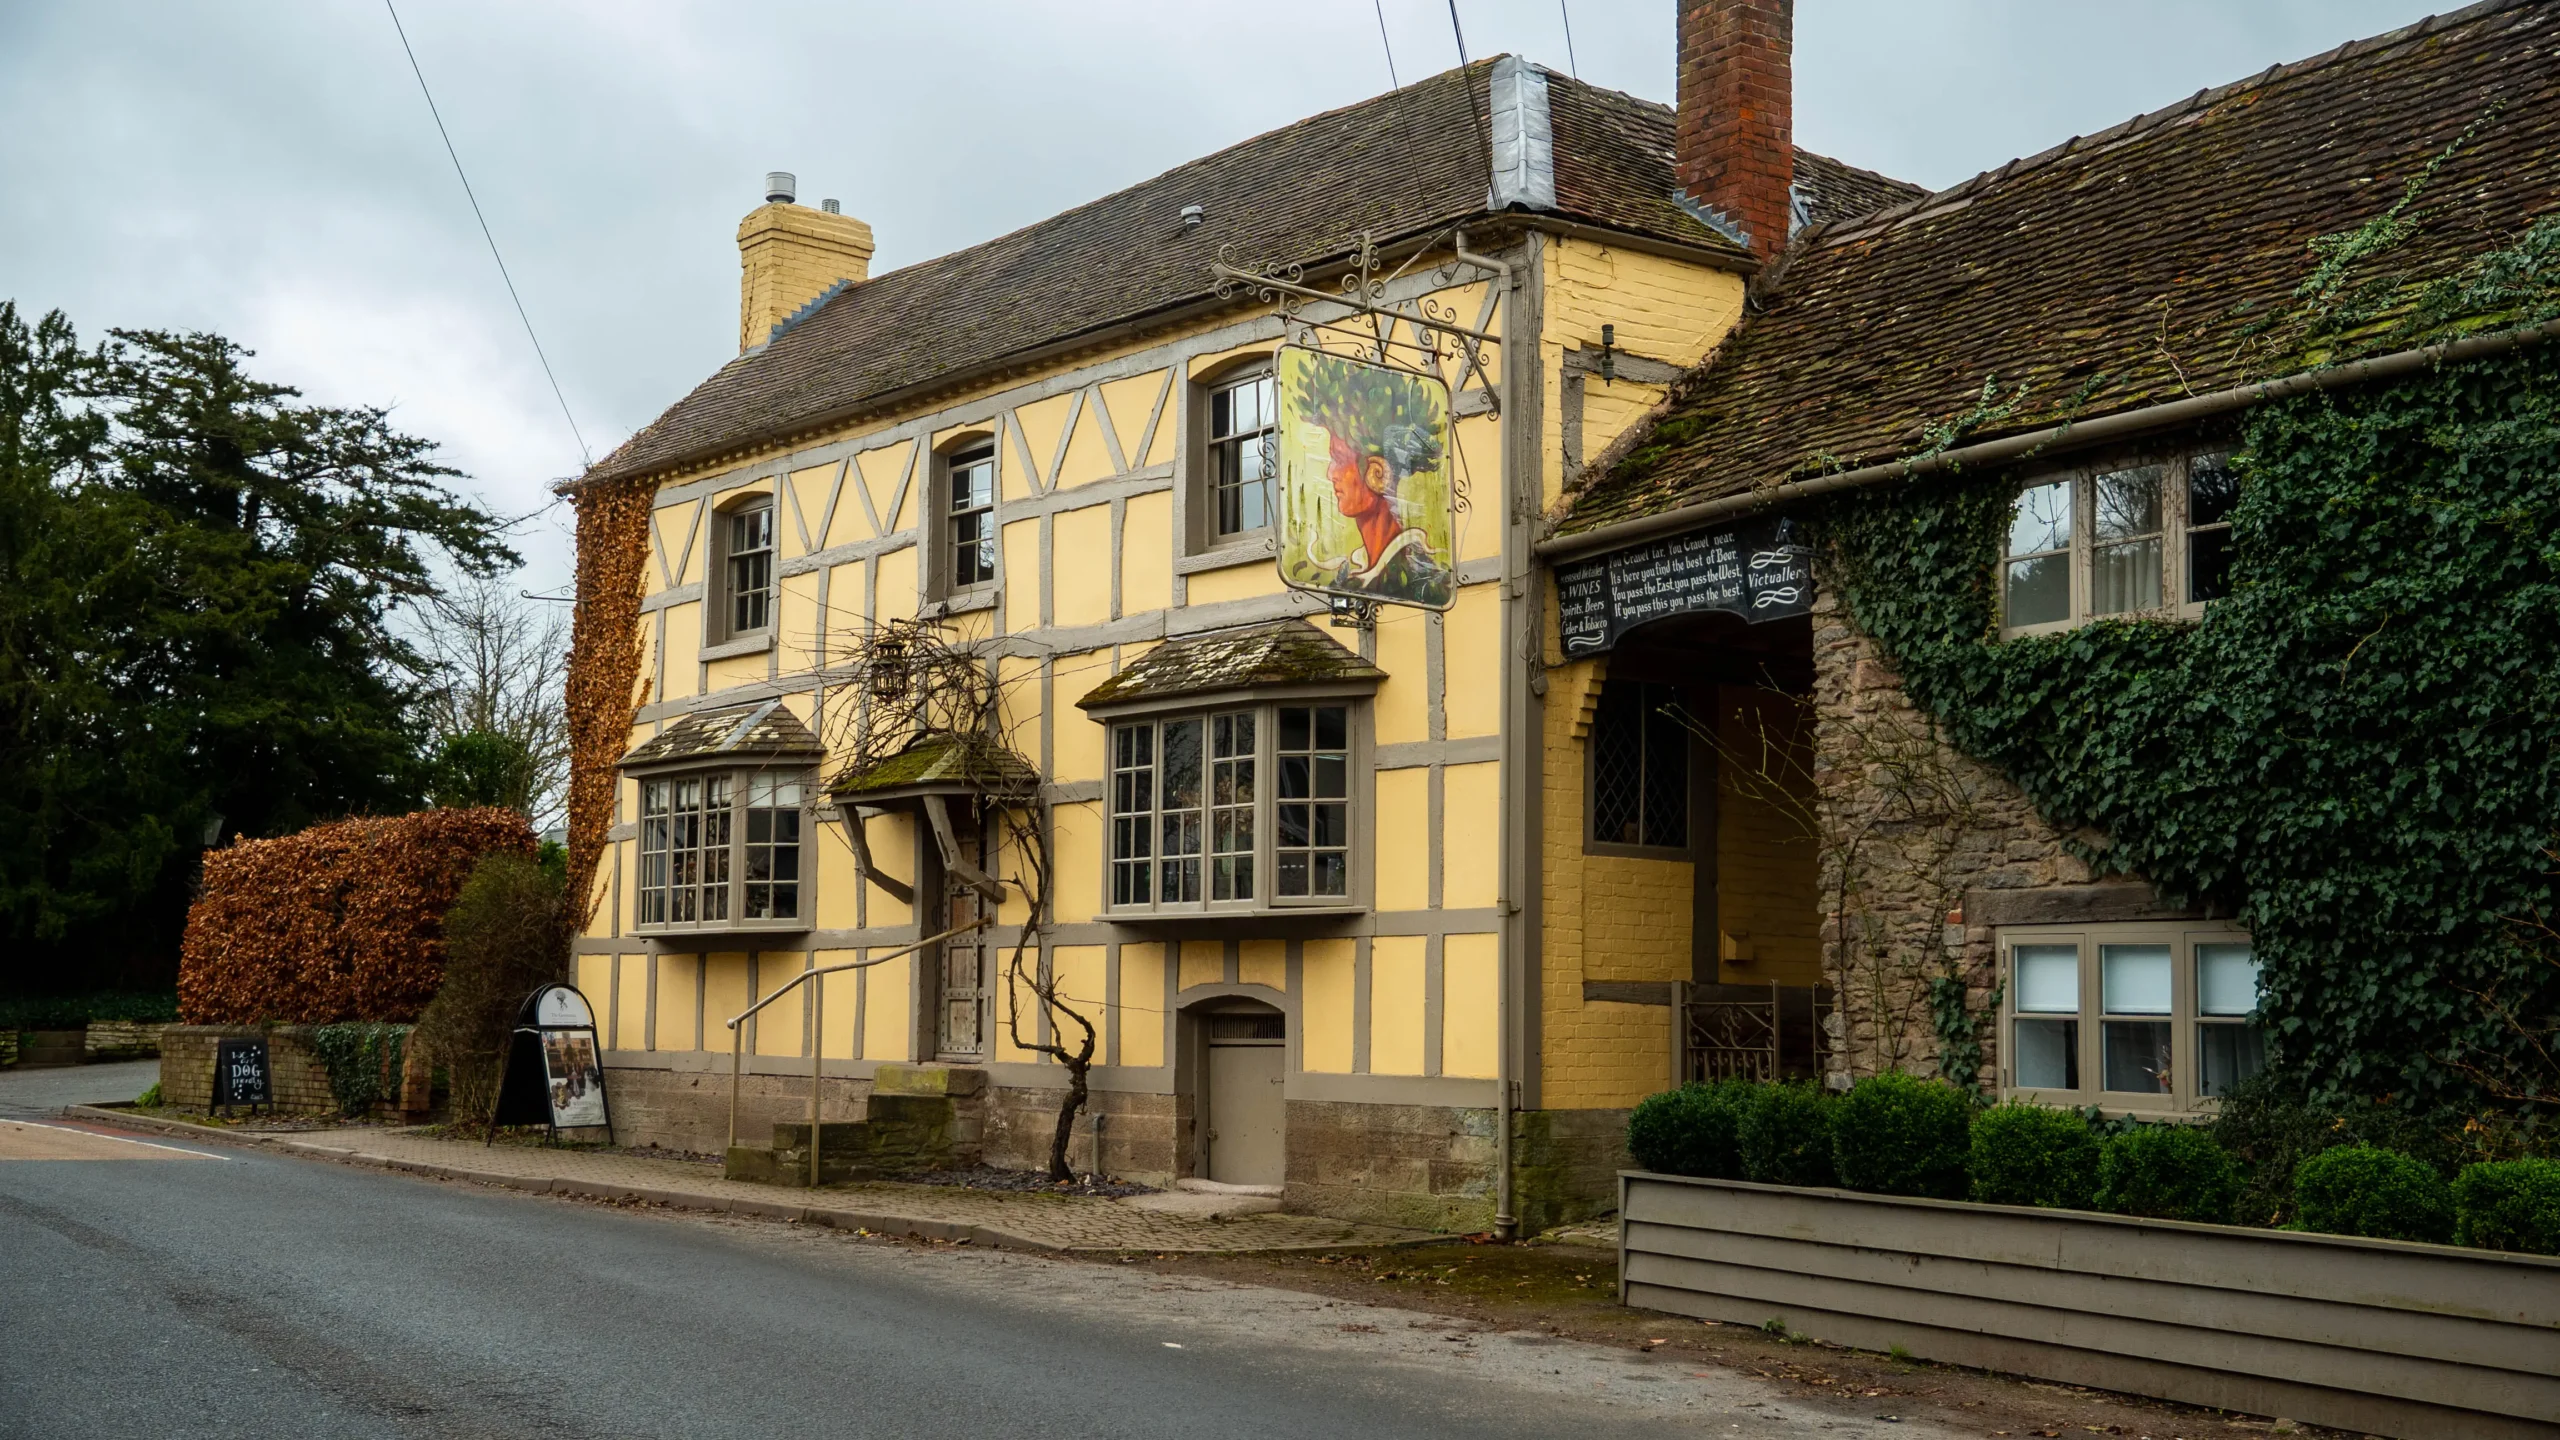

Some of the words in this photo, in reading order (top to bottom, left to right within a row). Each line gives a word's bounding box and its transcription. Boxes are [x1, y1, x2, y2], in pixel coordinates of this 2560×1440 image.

[1609, 554, 1622, 569] You
[1668, 541, 1682, 556] You
[1683, 534, 1709, 552] Travel
[1622, 568, 1640, 584] here
[1641, 568, 1656, 583] you
[1655, 559, 1670, 576] find
[1671, 558, 1685, 573] the
[1685, 554, 1703, 569] best
[1706, 548, 1715, 565] of
[1716, 547, 1738, 563] Beer.
[1612, 586, 1626, 602] You
[1626, 588, 1644, 604] pass
[1644, 581, 1656, 597] the
[1674, 577, 1690, 593] you
[1690, 575, 1707, 591] pass
[1707, 568, 1718, 584] the
[1748, 566, 1808, 588] Victuallers
[1569, 580, 1601, 598] WINES
[1585, 597, 1605, 613] Beers
[1614, 602, 1622, 617] If
[1622, 605, 1636, 619] you
[1636, 602, 1652, 618] pass
[1652, 597, 1668, 613] this
[1669, 596, 1684, 612] you
[1687, 592, 1705, 609] pass
[1706, 587, 1719, 602] the
[1561, 620, 1578, 636] Cider
[1578, 620, 1584, 633] &
[1584, 616, 1608, 632] Tobacco
[231, 1064, 263, 1078] DOG
